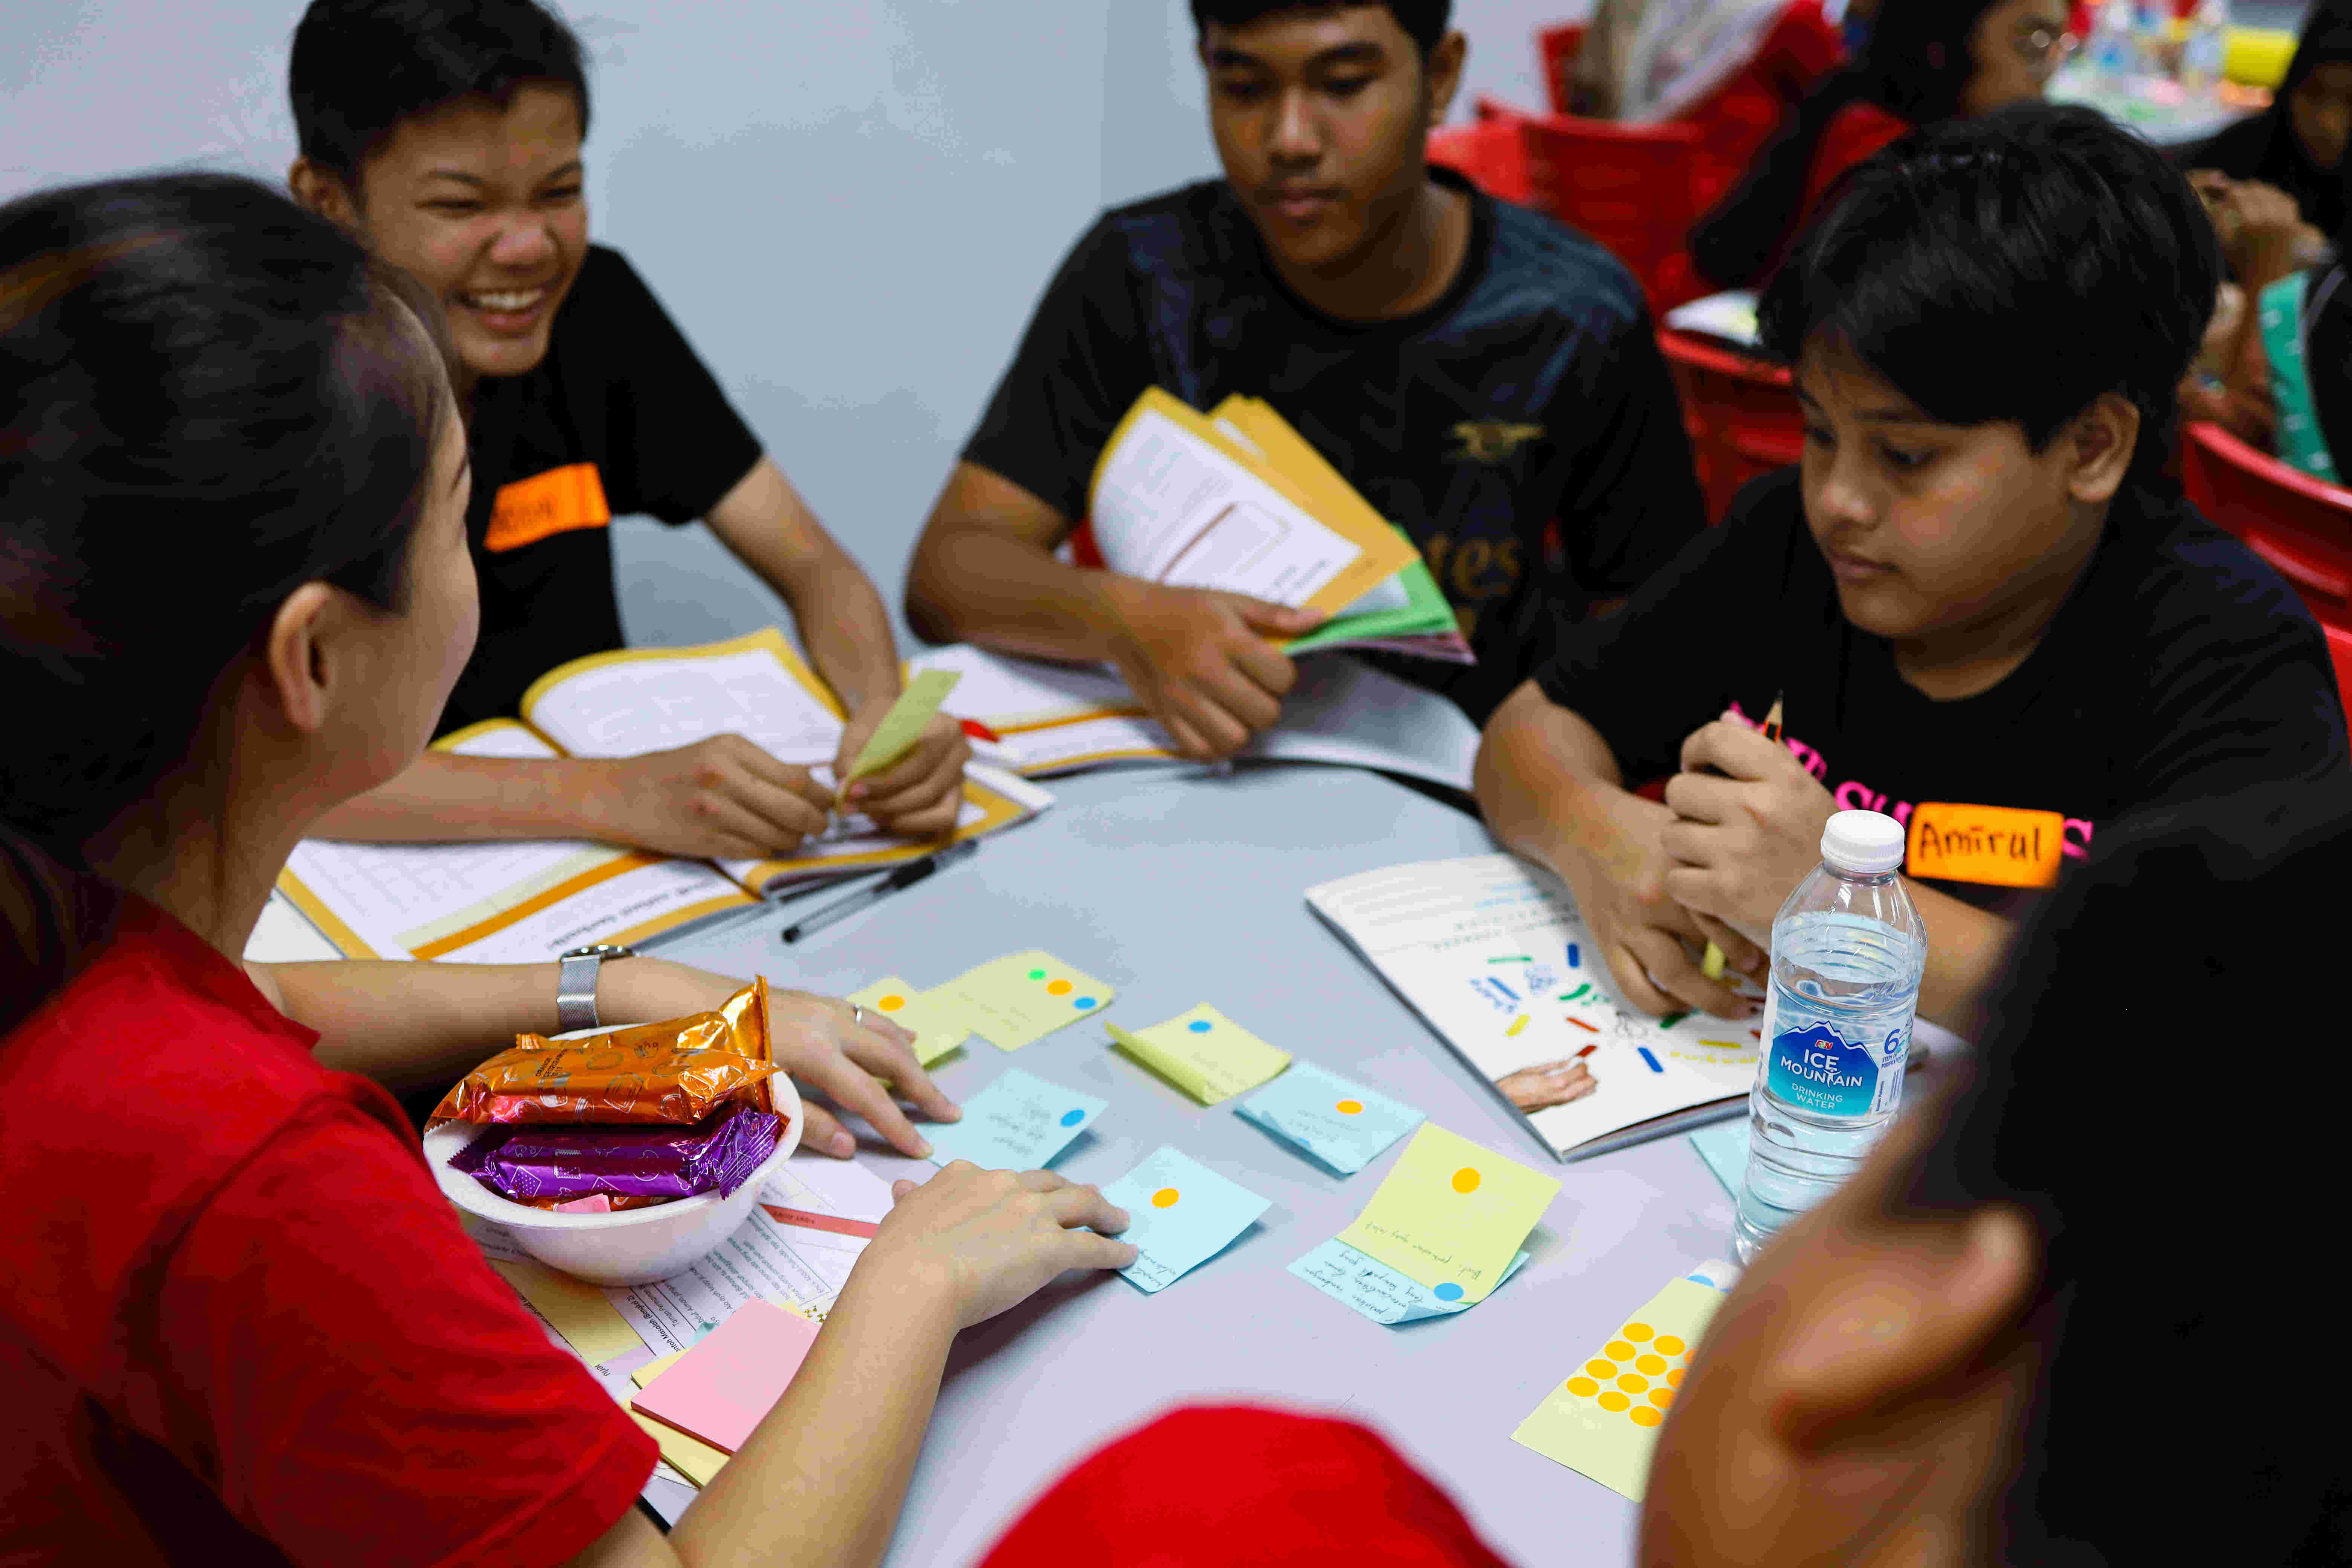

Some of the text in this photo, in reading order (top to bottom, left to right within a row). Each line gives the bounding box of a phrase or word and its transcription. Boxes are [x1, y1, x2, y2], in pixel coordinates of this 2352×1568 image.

[1919, 822, 2041, 862] Amirul
[1884, 1029, 1900, 1054] 6
[1804, 1049, 1839, 1071] ICE
[1781, 1055, 1862, 1088] MOUNTAIN
[1792, 1083, 1843, 1102] DRINKING
[1797, 1093, 1835, 1109] WATER
[648, 1318, 669, 1340] Masalah
